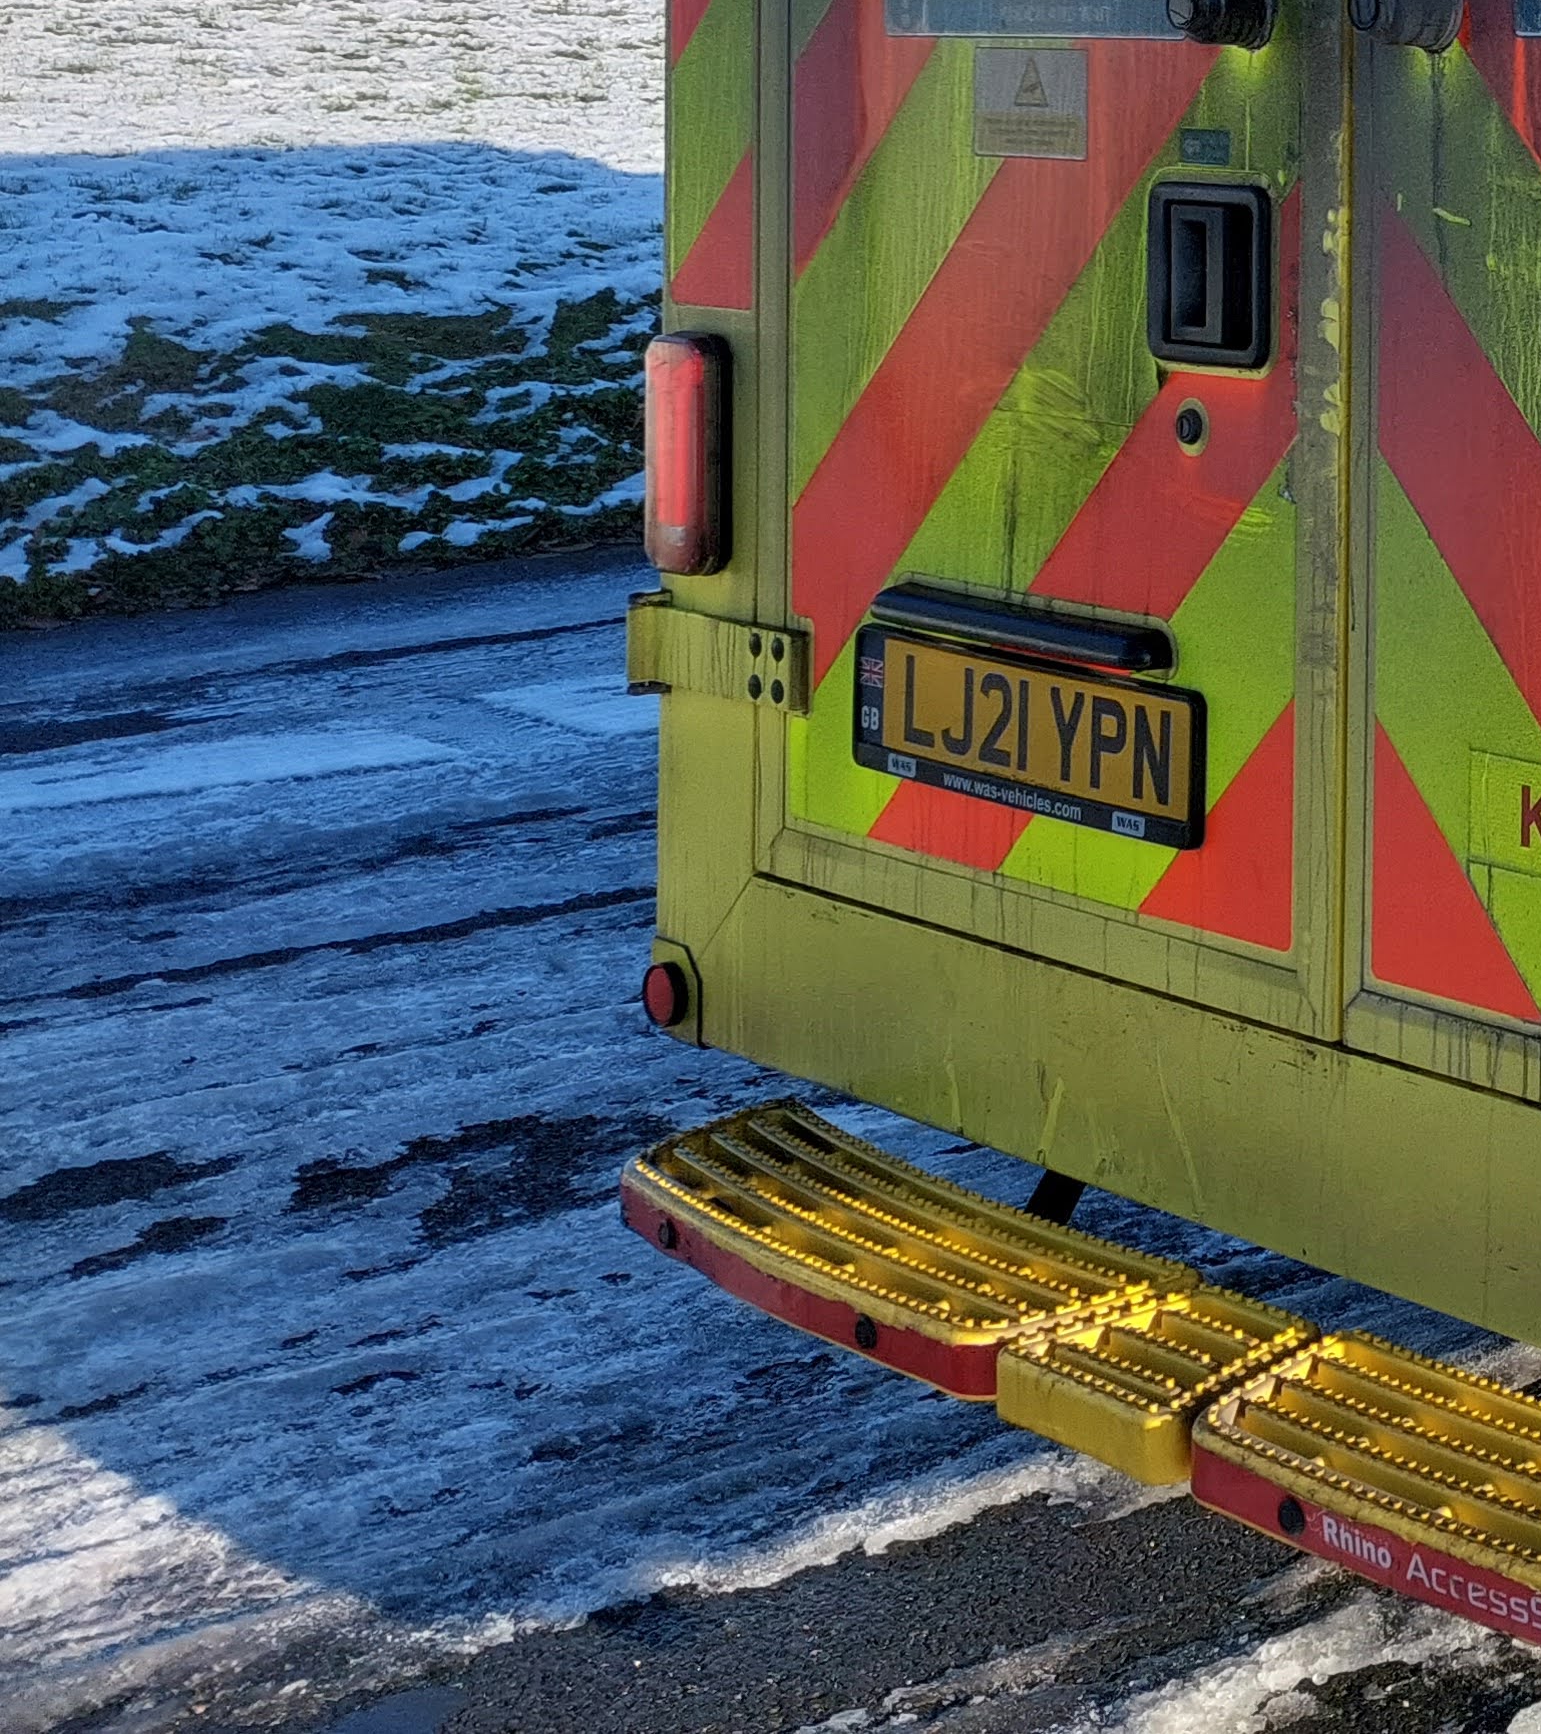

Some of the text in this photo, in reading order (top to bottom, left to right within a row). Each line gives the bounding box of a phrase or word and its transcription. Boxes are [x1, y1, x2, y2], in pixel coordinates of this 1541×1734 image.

[861, 705, 880, 732] GB
[904, 654, 1172, 807] LJ21 YPN
[943, 772, 1082, 822] www.was-vehicles.com
[1116, 816, 1141, 832] WAS
[1322, 1514, 1392, 1569] Rhino
